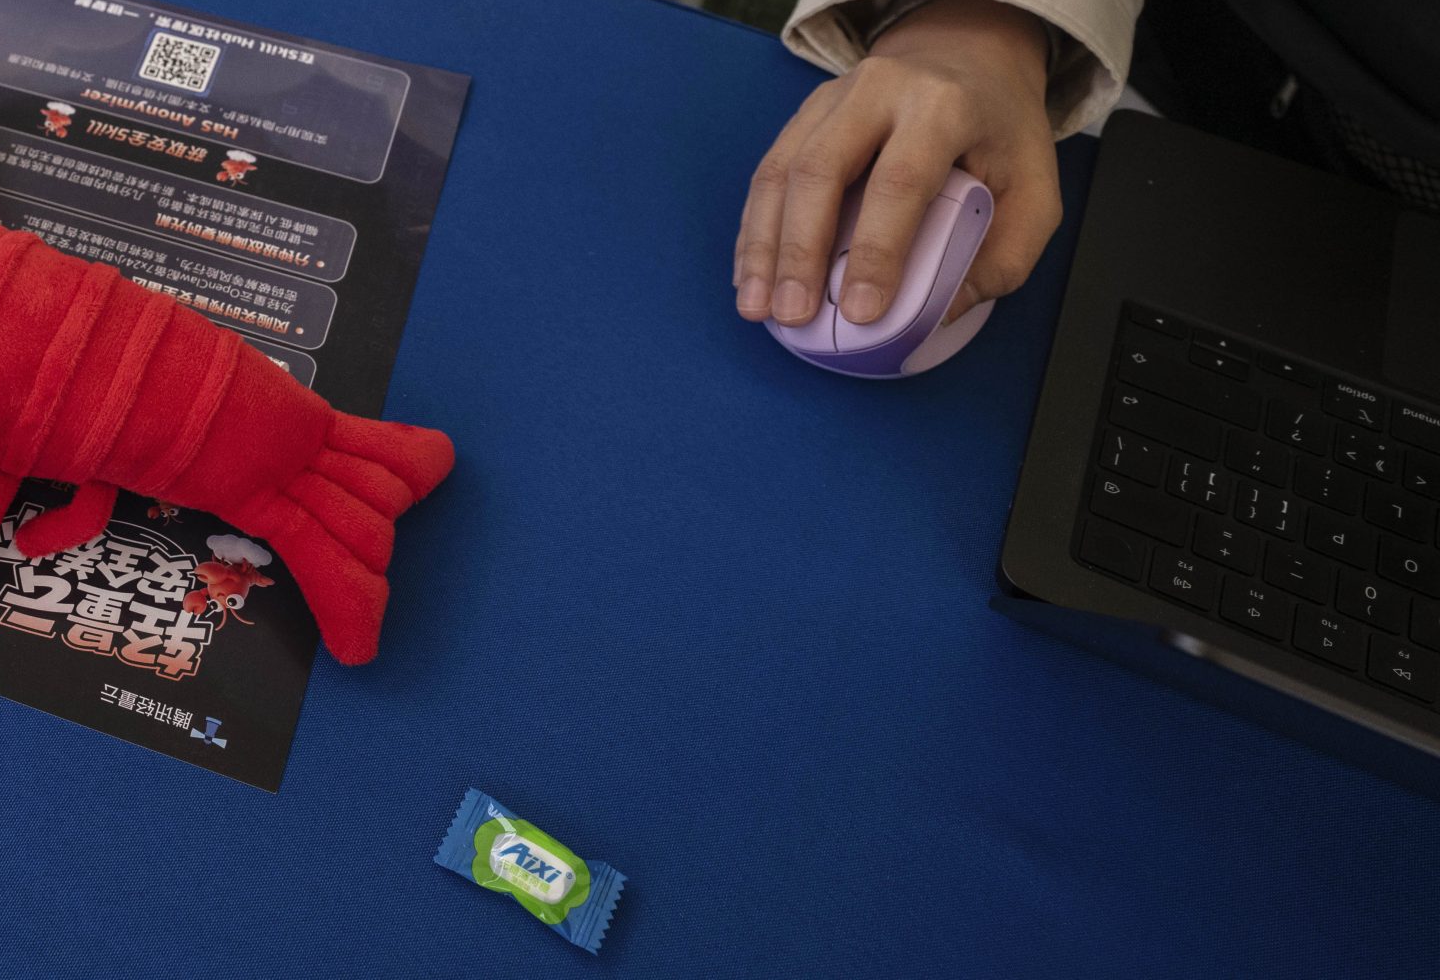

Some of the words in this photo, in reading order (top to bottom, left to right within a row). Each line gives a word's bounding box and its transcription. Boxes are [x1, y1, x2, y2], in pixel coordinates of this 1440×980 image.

[81, 87, 196, 125] Anonymizer
[200, 118, 239, 138] HaS
[86, 118, 208, 162] 获取安全Skill
[263, 213, 278, 225] AI
[155, 211, 310, 265] 分钟级故障恢复时光机
[1338, 383, 1376, 402] option
[1332, 533, 1345, 546] P
[1177, 559, 1194, 572] F12
[1249, 588, 1264, 600] F11
[0, 564, 210, 678] 轻量云
[1321, 618, 1338, 630] F10
[1398, 650, 1410, 659] F9
[99, 682, 194, 730] 腾讯轻量云
[497, 842, 563, 884] Aixi
